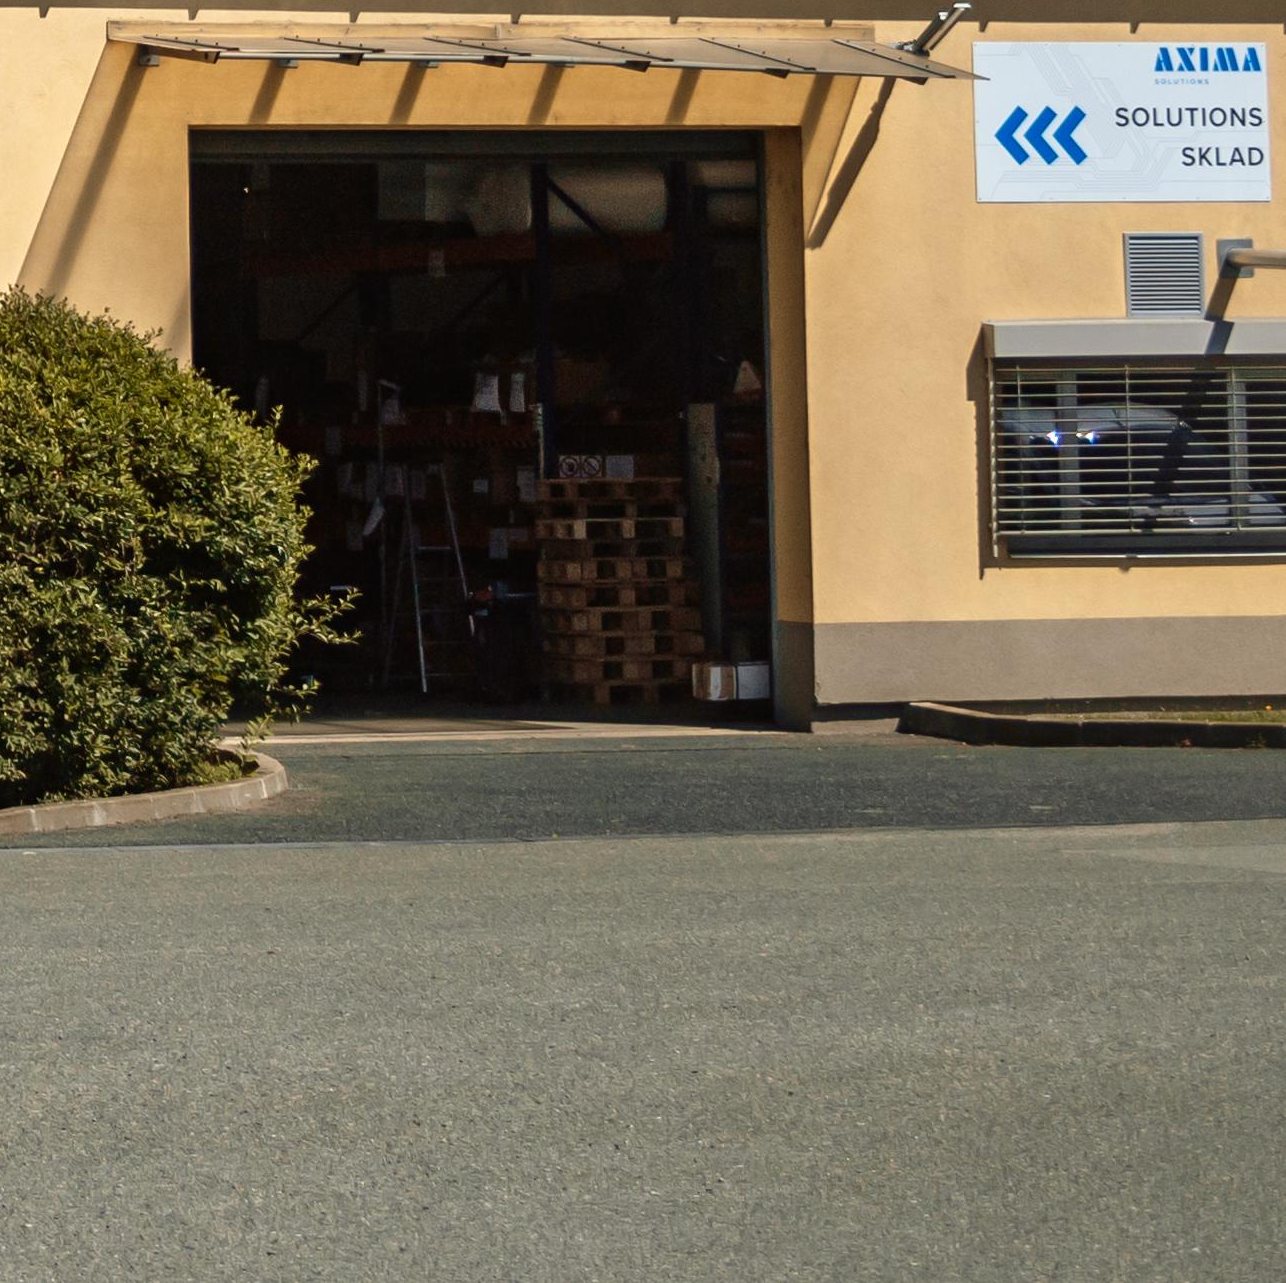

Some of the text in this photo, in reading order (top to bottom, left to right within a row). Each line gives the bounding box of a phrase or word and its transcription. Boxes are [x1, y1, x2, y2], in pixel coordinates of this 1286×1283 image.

[1155, 47, 1262, 72] AXIMA
[1115, 107, 1263, 127] SOLUTIONS
[1181, 147, 1264, 167] SKLAD
